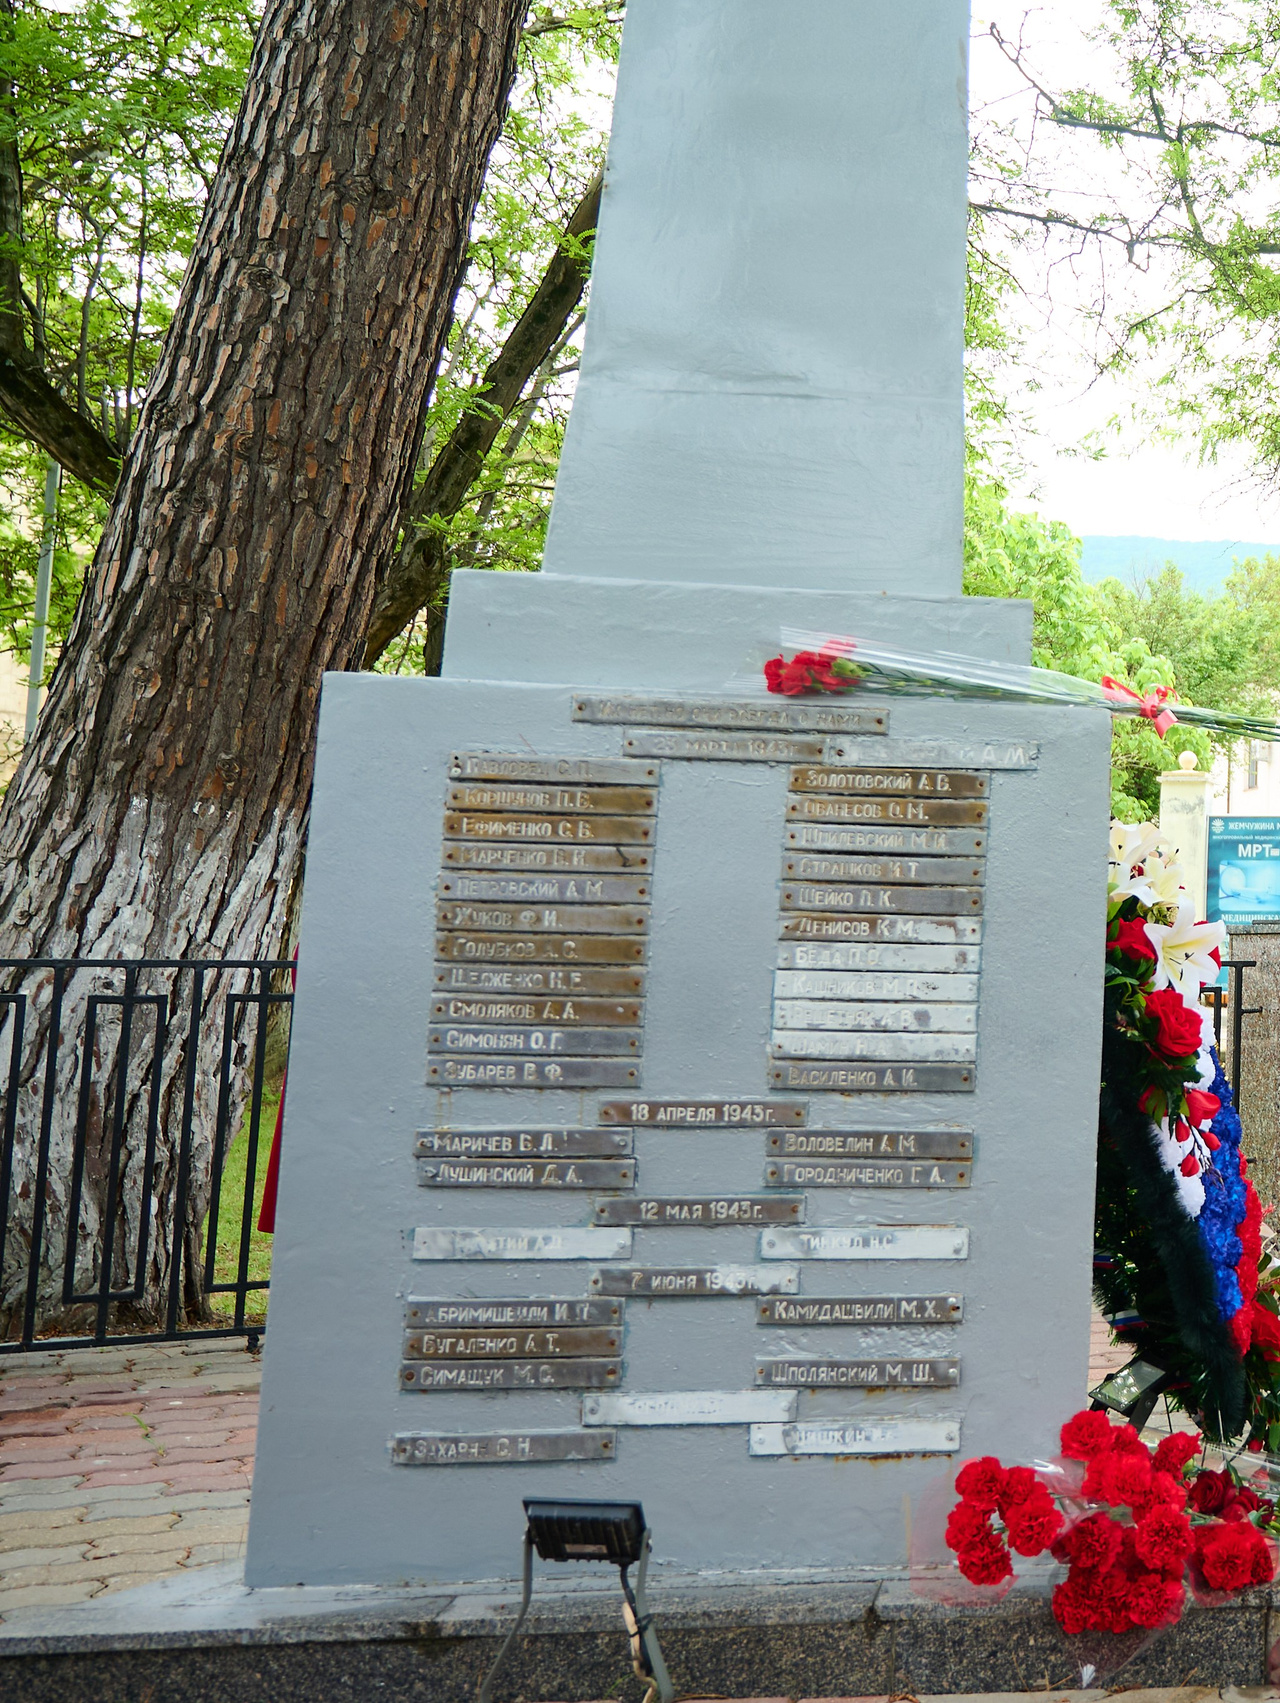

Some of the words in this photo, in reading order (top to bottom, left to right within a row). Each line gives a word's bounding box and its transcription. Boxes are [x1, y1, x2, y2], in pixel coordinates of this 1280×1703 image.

[1229, 822, 1274, 830] ЖЕМЧУЖИНА
[1238, 844, 1272, 858] МРТ
[631, 1104, 649, 1121] 18
[657, 1107, 715, 1121] АПРЕЛЯ
[640, 1202, 658, 1219] 12
[666, 1205, 702, 1219] МАЯ
[632, 1273, 643, 1289] 7
[652, 1275, 696, 1289] ИЮНЯ
